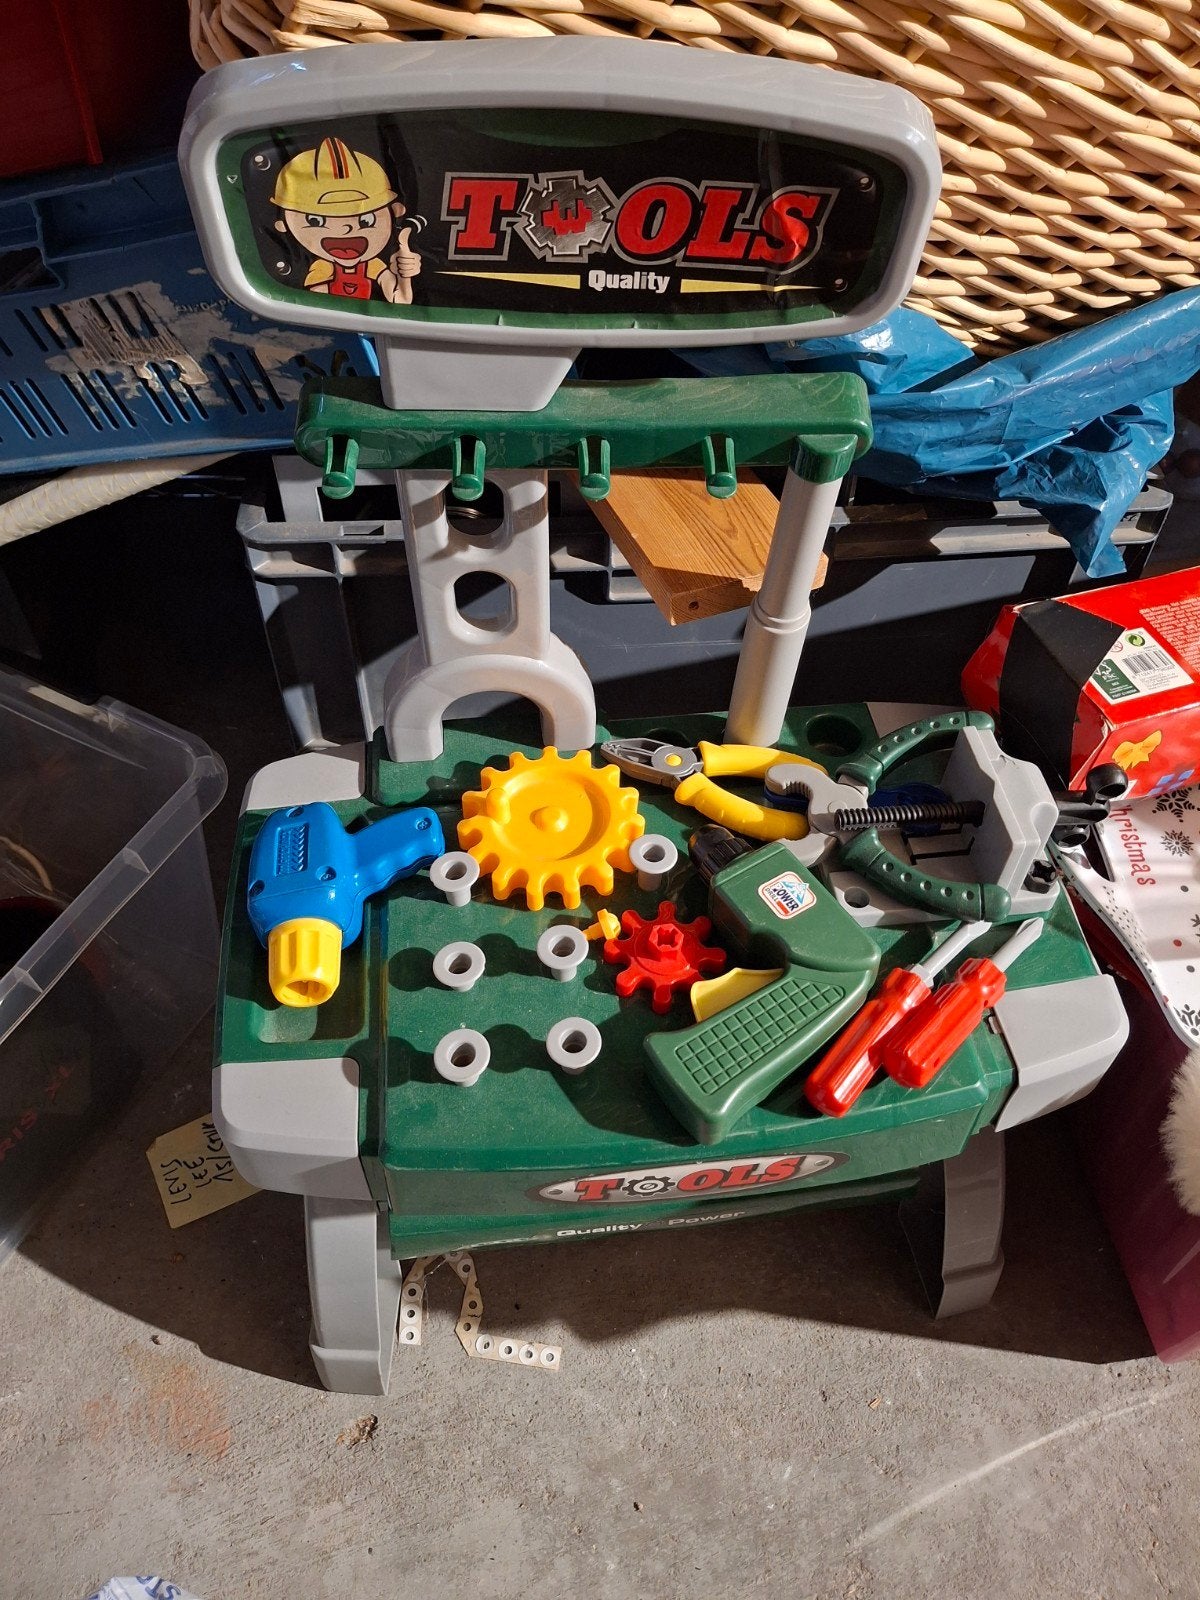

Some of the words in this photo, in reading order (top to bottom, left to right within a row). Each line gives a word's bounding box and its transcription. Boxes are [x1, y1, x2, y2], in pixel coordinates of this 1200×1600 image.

[588, 269, 671, 294] Quality
[1109, 803, 1156, 886] hristmas
[160, 1158, 193, 1205] LEVIS
[183, 1156, 212, 1188] LEE
[556, 1222, 643, 1237] Quality
[668, 1210, 747, 1226] Power
